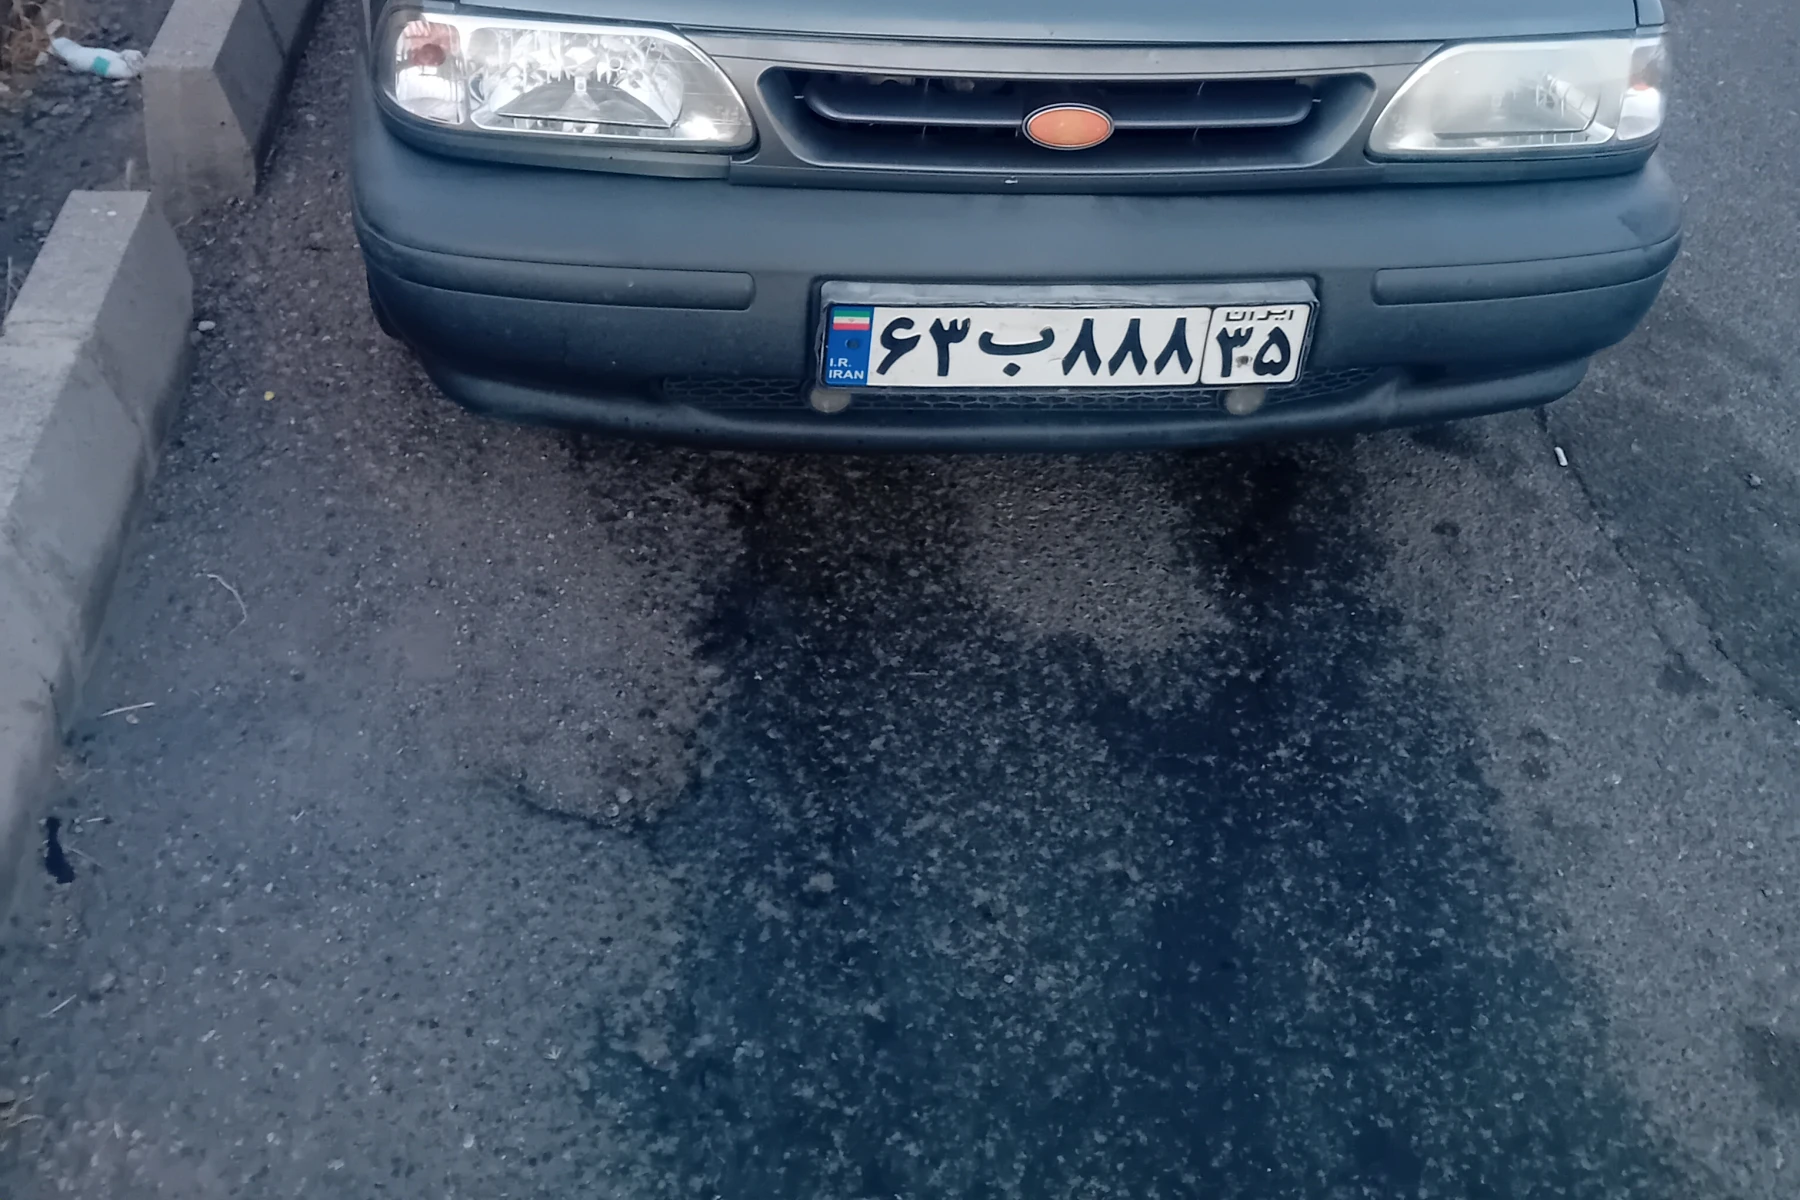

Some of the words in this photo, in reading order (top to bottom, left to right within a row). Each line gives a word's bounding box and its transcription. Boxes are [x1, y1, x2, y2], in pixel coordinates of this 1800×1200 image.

[1225, 309, 1294, 322] ایران
[1215, 326, 1291, 378] ۳۵
[829, 357, 852, 368] I.R.
[828, 369, 865, 380] IRAN
